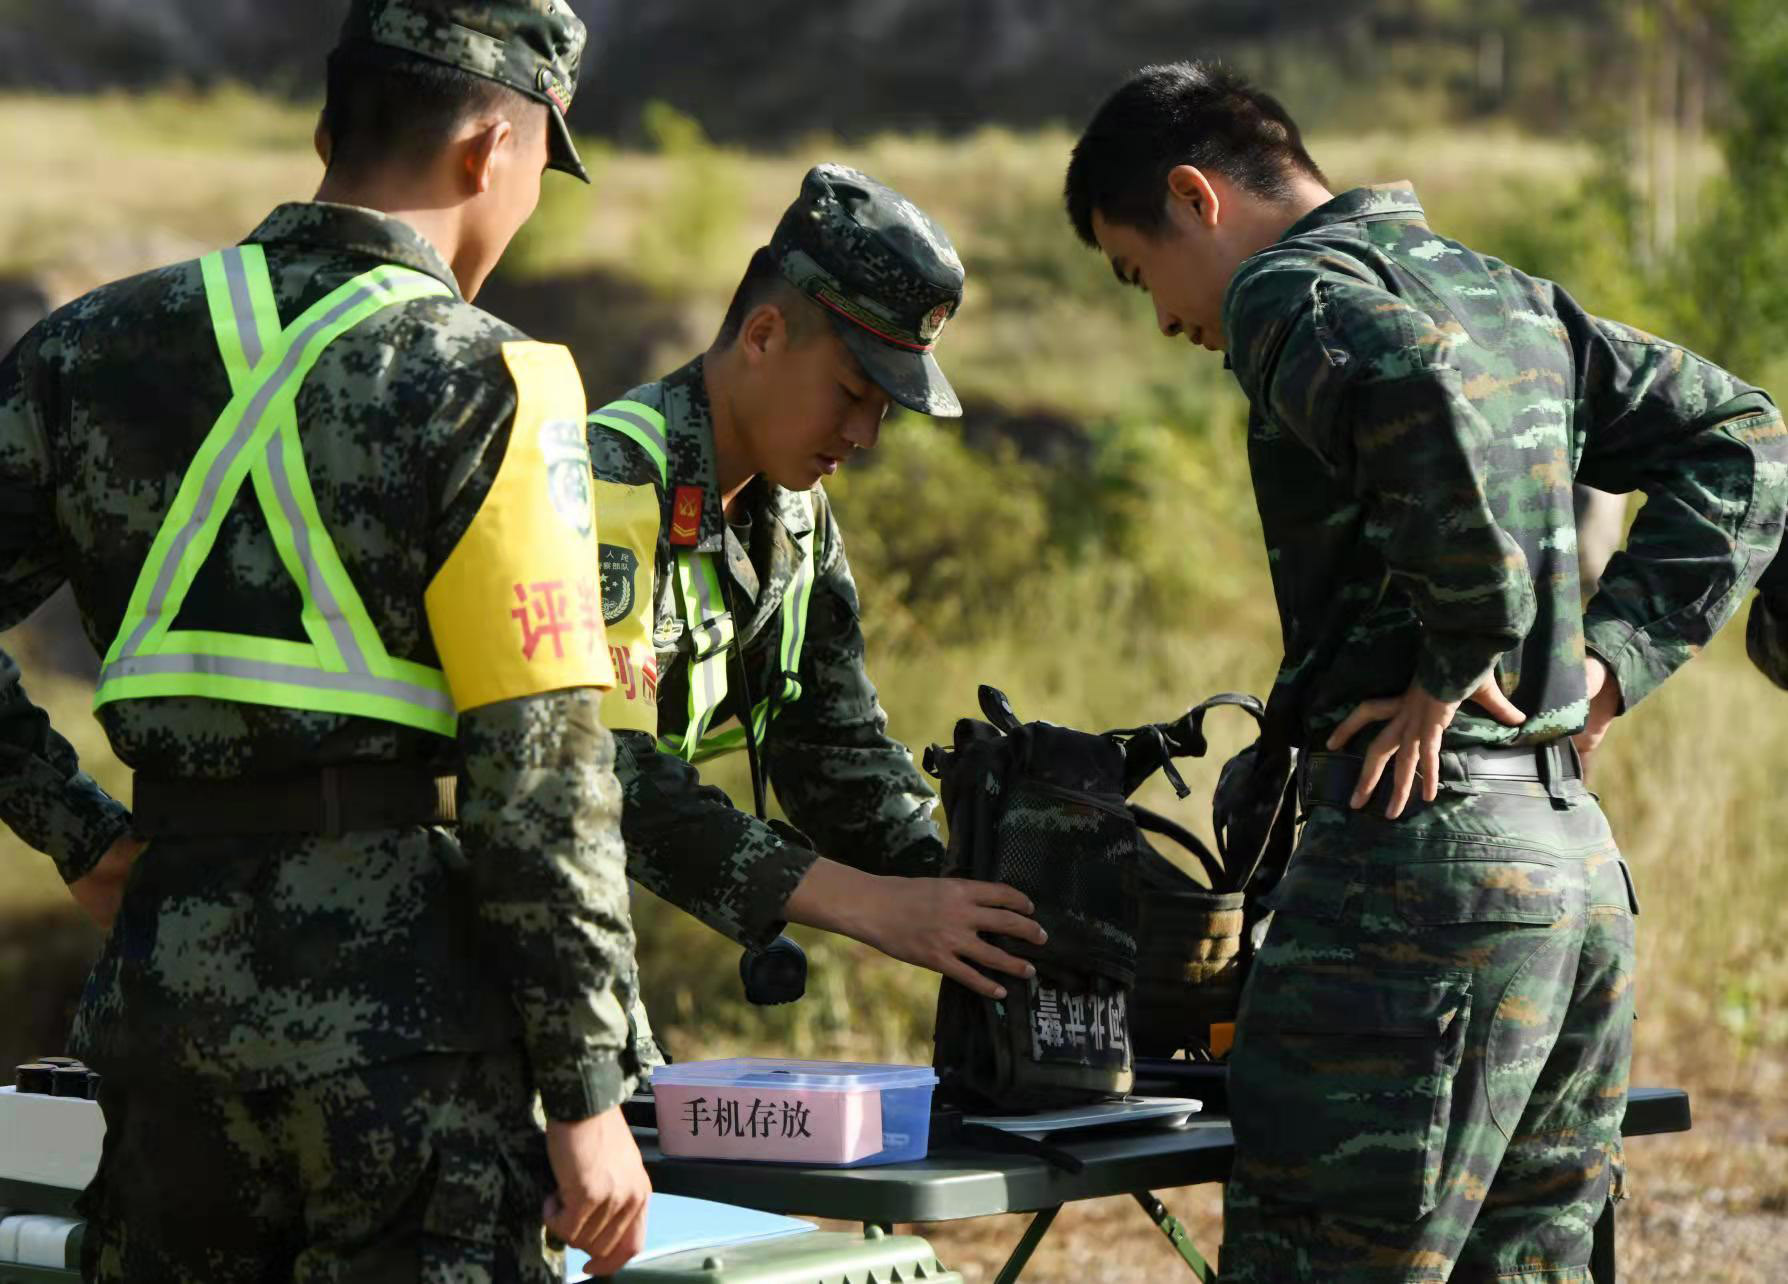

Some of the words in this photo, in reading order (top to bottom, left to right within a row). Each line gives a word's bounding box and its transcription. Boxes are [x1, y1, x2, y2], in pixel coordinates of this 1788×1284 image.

[600, 562, 629, 571] 察部队
[1036, 987, 1126, 1051] 河北武警
[680, 1096, 812, 1139] 手机存放
